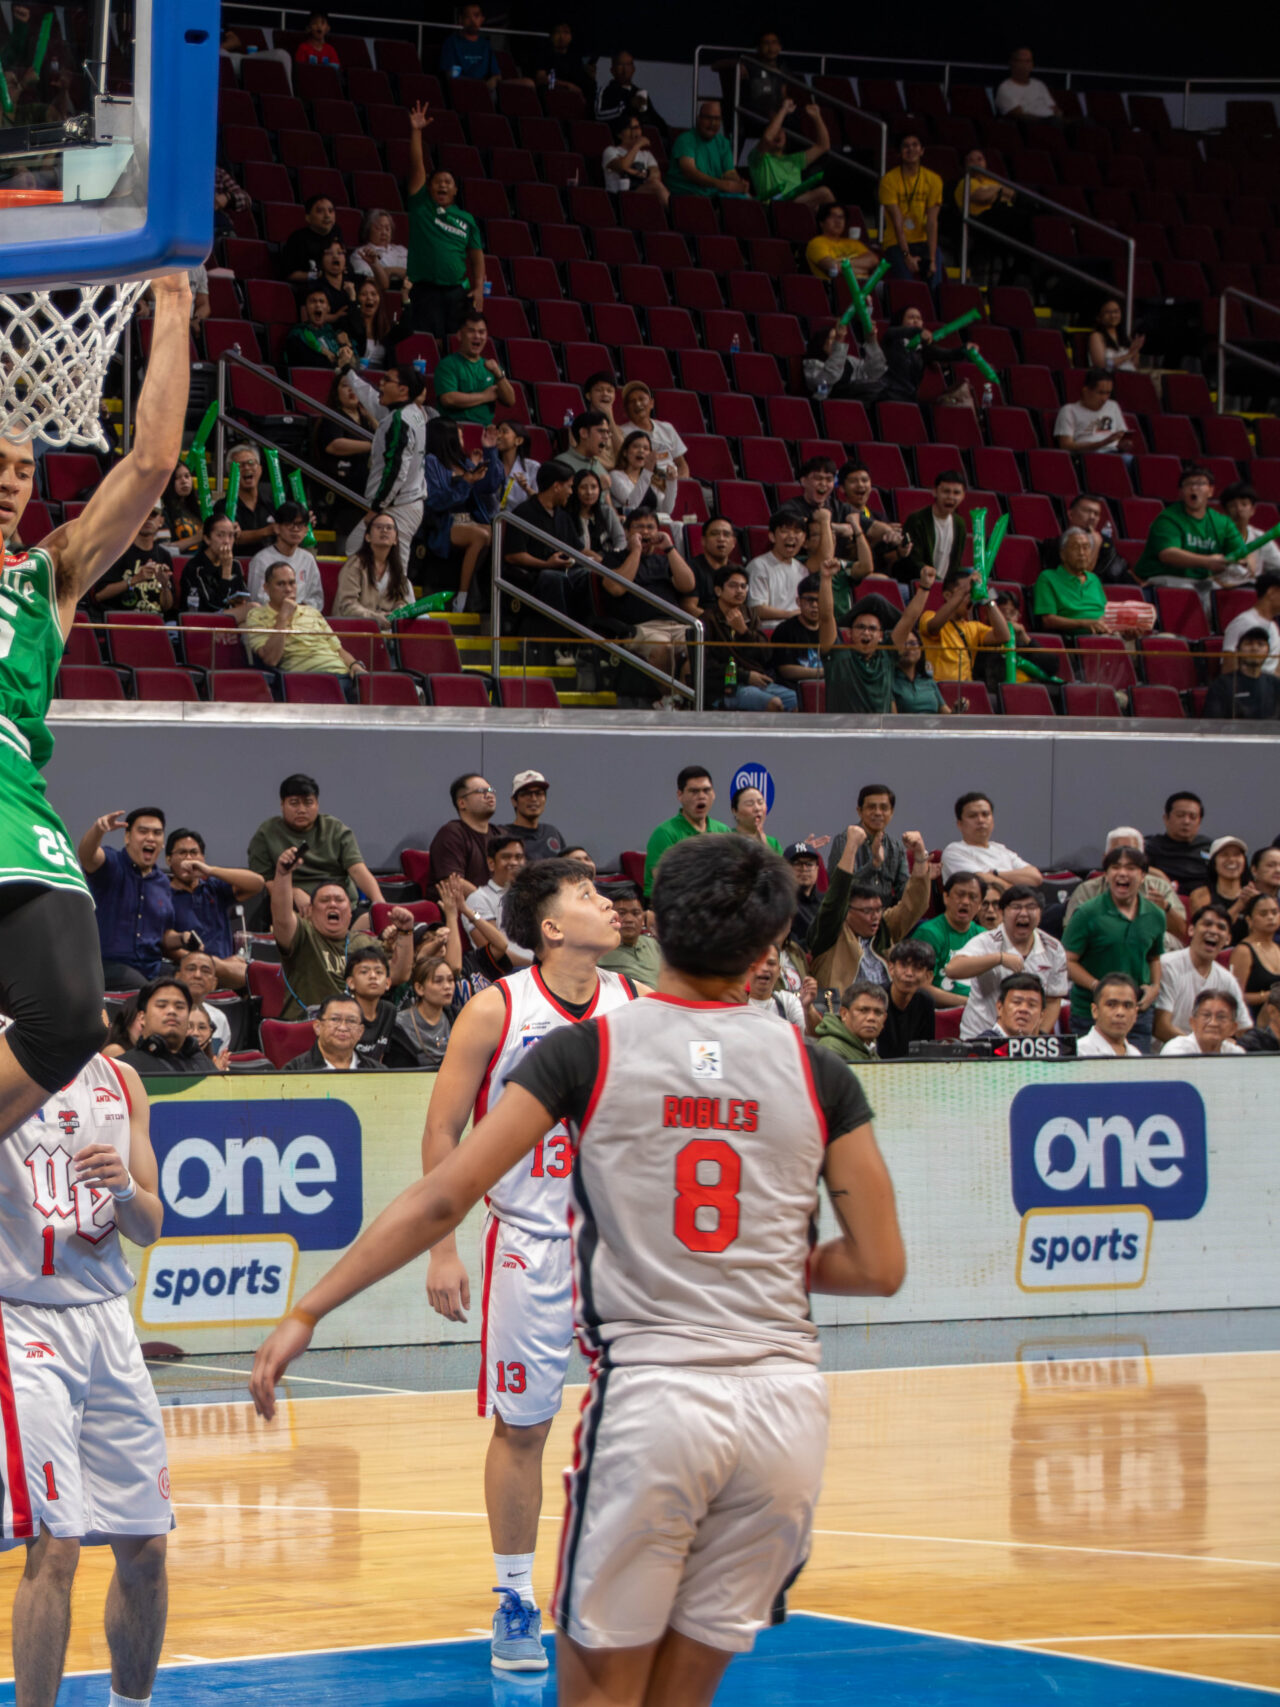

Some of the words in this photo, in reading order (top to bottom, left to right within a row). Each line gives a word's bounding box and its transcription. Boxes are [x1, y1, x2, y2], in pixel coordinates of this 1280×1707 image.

[1008, 1037, 1060, 1058] POSS
[663, 1094, 759, 1133] ROBLES
[531, 1134, 574, 1179] 13
[1034, 1113, 1186, 1192] one
[161, 1134, 338, 1219] one
[673, 1138, 742, 1253] 8
[41, 1224, 55, 1276] 1
[1029, 1228, 1139, 1271] sports
[152, 1258, 282, 1306] sports
[26, 1350, 44, 1359] ANTA
[496, 1360, 527, 1394] 13
[42, 1460, 60, 1502] 1
